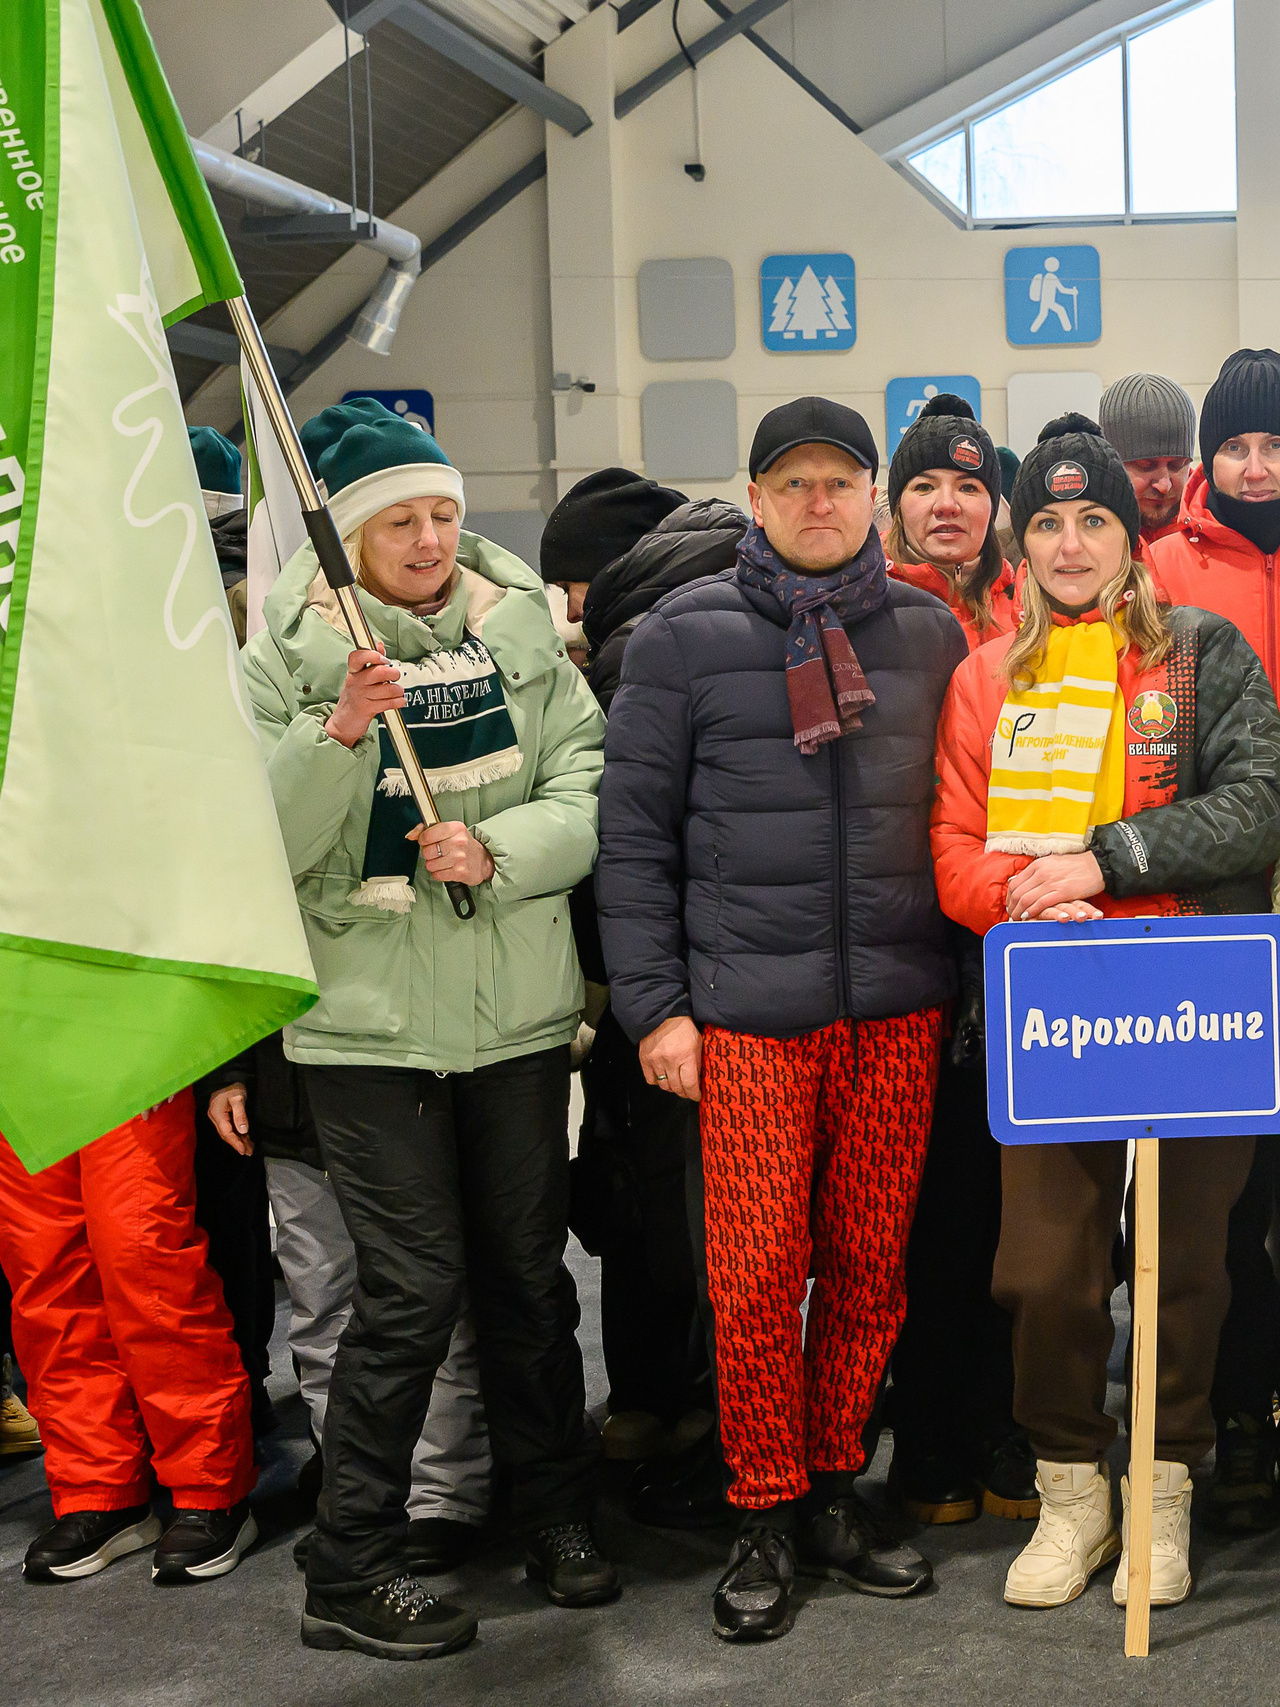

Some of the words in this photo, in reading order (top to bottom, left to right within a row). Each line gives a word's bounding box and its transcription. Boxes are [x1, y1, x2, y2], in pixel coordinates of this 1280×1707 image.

[403, 679, 492, 707] РАНИТЕЛИ
[1128, 743, 1177, 755] BELARUS
[1021, 999, 1265, 1060] Агрохолдинг
